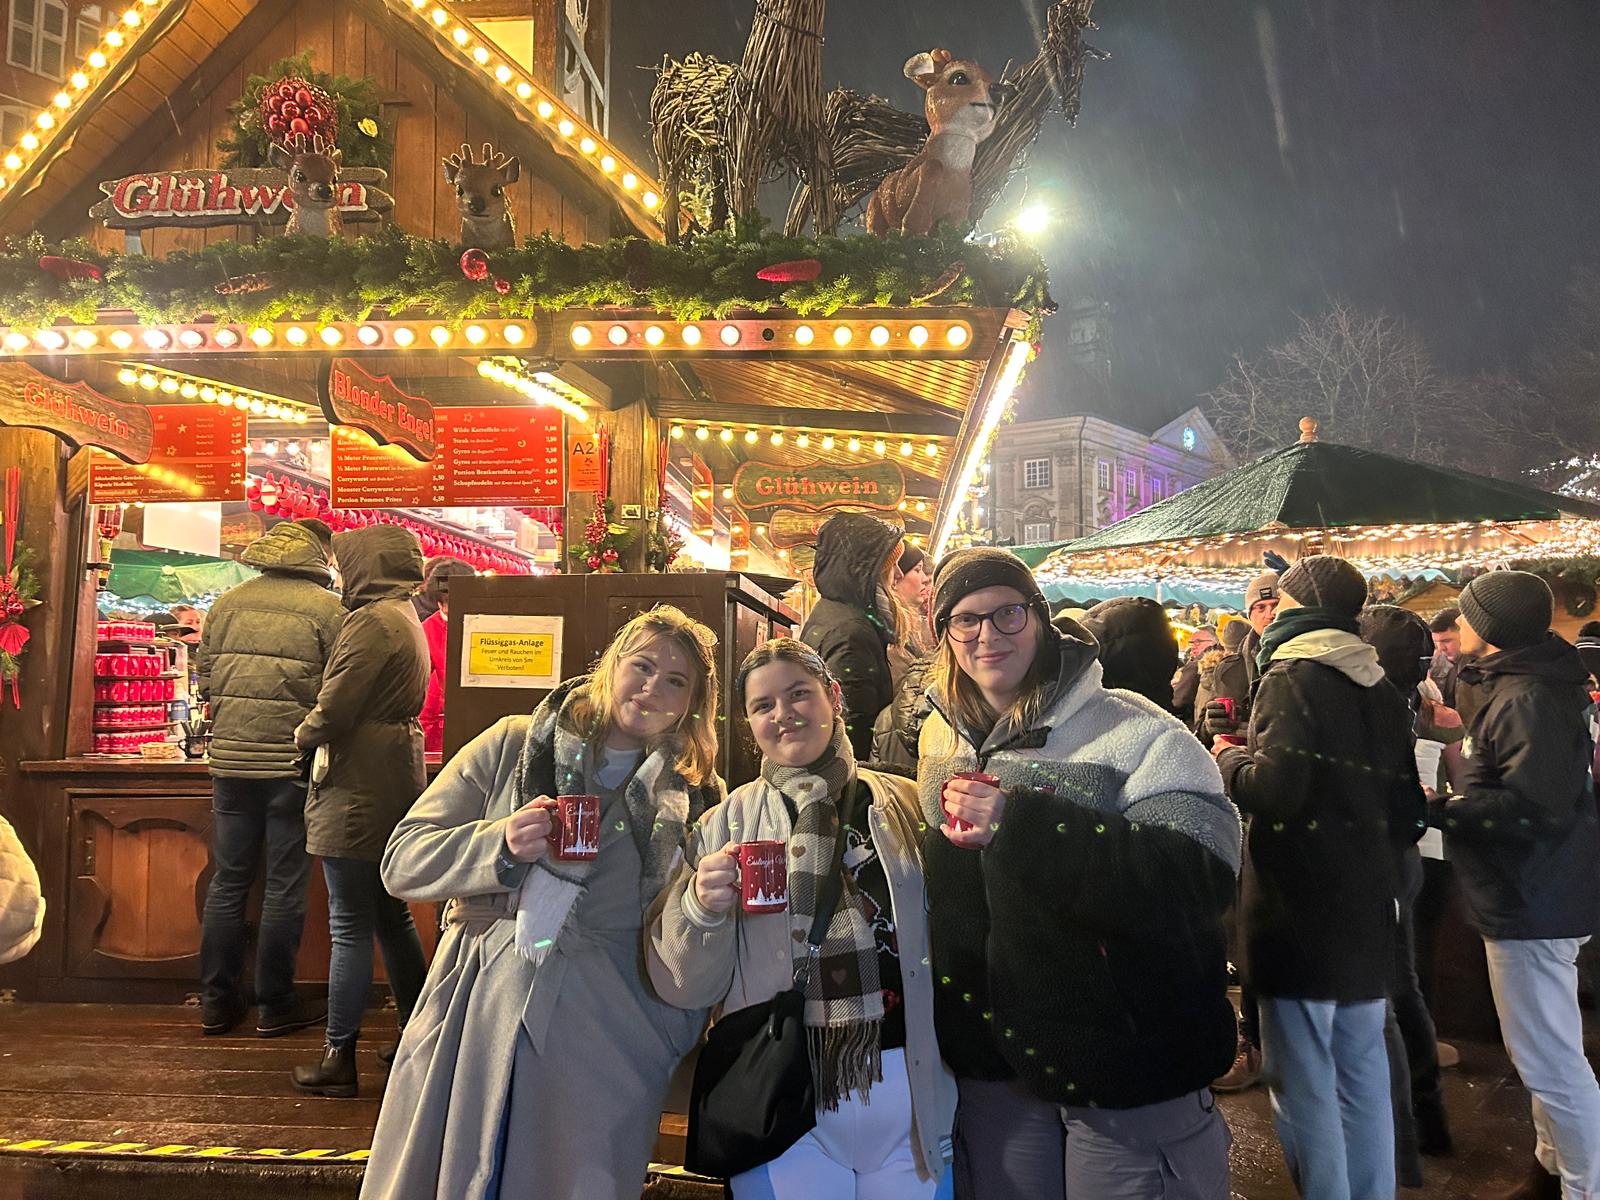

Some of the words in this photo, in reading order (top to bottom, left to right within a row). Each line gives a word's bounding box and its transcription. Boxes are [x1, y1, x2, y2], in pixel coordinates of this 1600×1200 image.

[112, 173, 368, 219] Glühwn
[23, 382, 130, 440] Glühwein
[334, 370, 395, 422] Blonder
[396, 401, 435, 444] Engel
[572, 441, 595, 456] A2
[361, 486, 394, 494] Currywurst
[755, 475, 879, 497] Glühwein
[480, 638, 544, 647] Flüssiggas-Anlage
[509, 648, 533, 656] Rauchen
